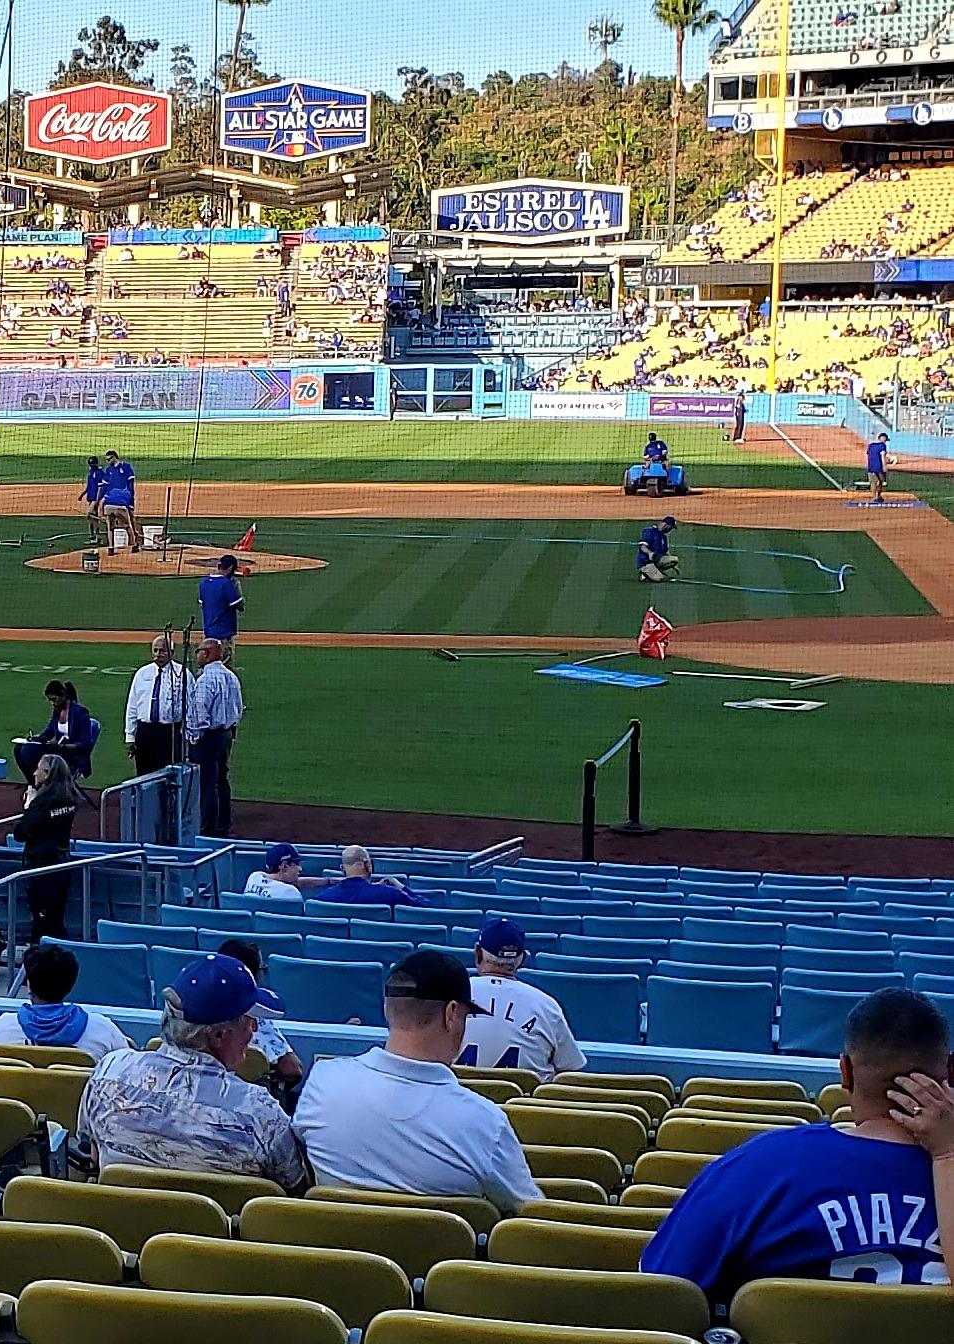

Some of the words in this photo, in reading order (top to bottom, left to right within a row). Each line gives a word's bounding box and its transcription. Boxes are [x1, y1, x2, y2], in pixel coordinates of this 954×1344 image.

[309, 110, 364, 128] GAME
[450, 211, 575, 233] JALISCO
[296, 382, 318, 400] 76
[21, 393, 97, 409] GAME
[105, 393, 177, 409] PLAN
